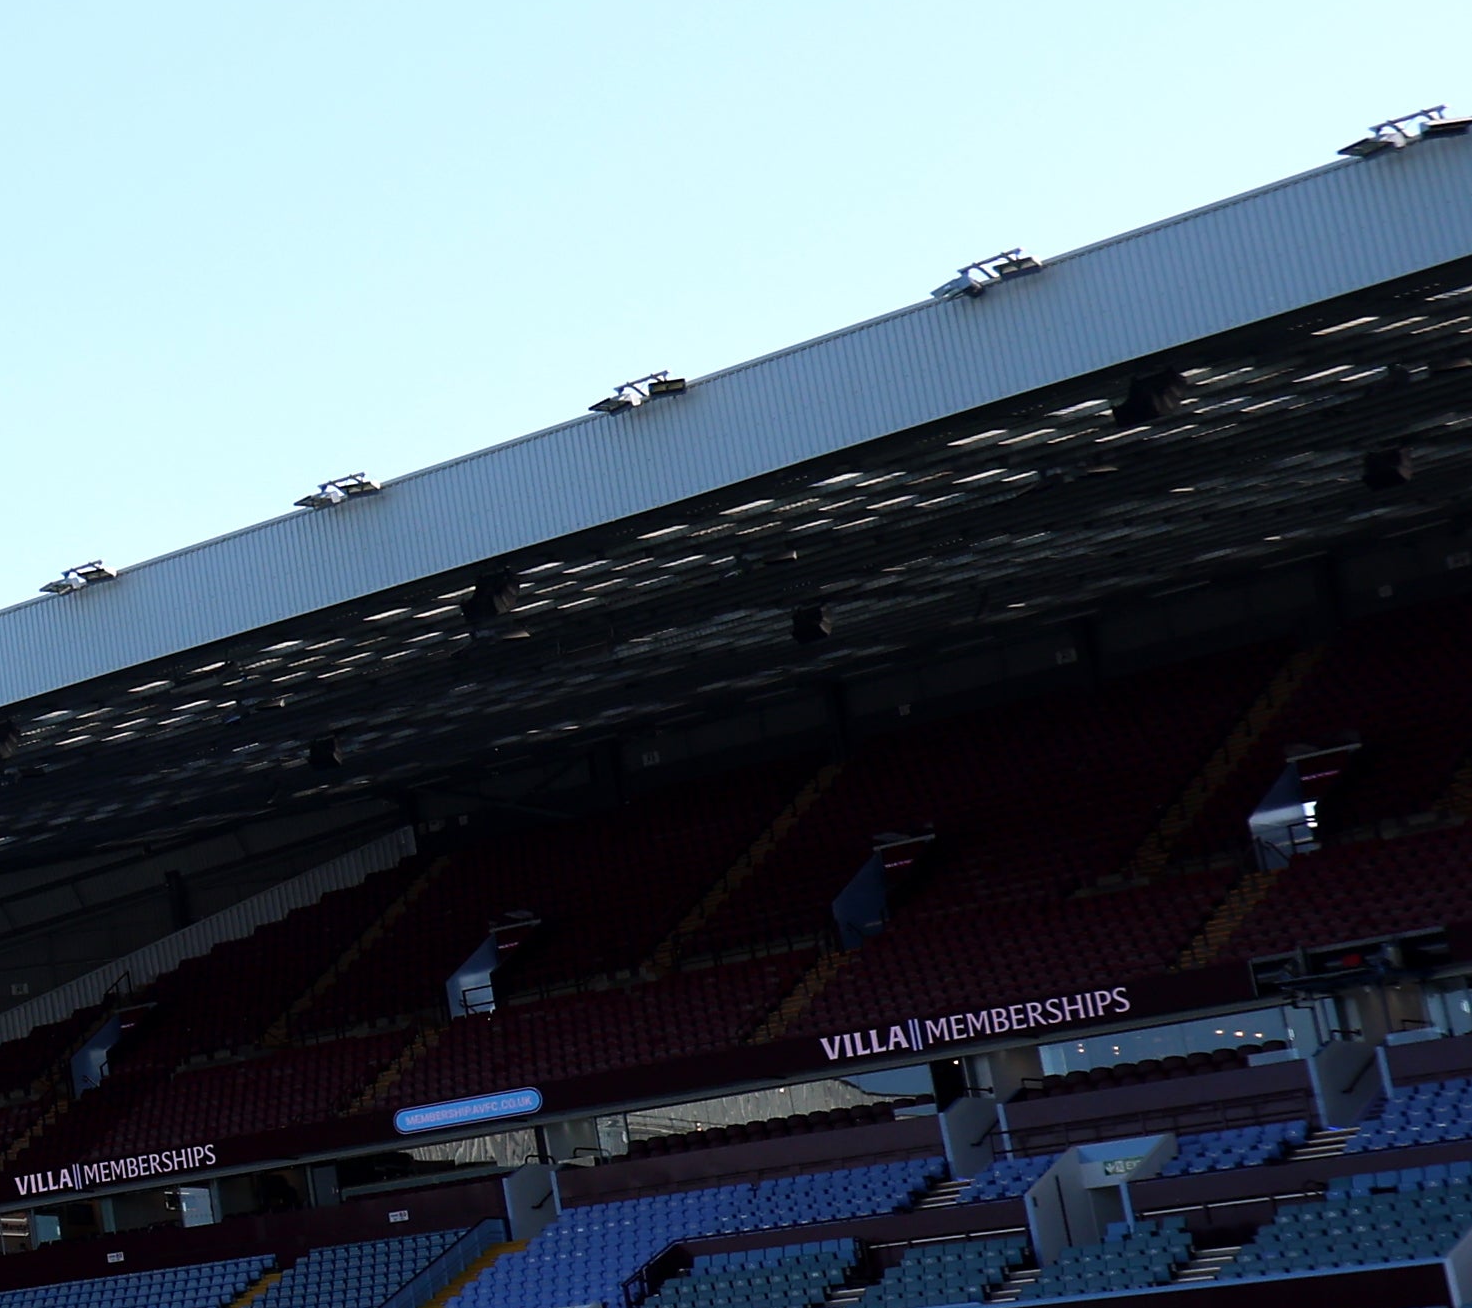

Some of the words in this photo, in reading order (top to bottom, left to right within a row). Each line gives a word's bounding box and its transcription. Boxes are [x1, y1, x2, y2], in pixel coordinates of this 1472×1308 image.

[820, 1025, 910, 1060] VILLA
[925, 987, 1131, 1044] MEMBERSHIPS
[404, 1095, 533, 1126] MEMBERSHIP.AVFC.CO.UK
[14, 1168, 73, 1196] VILLA
[83, 1144, 216, 1185] MEMBERSHIPS
